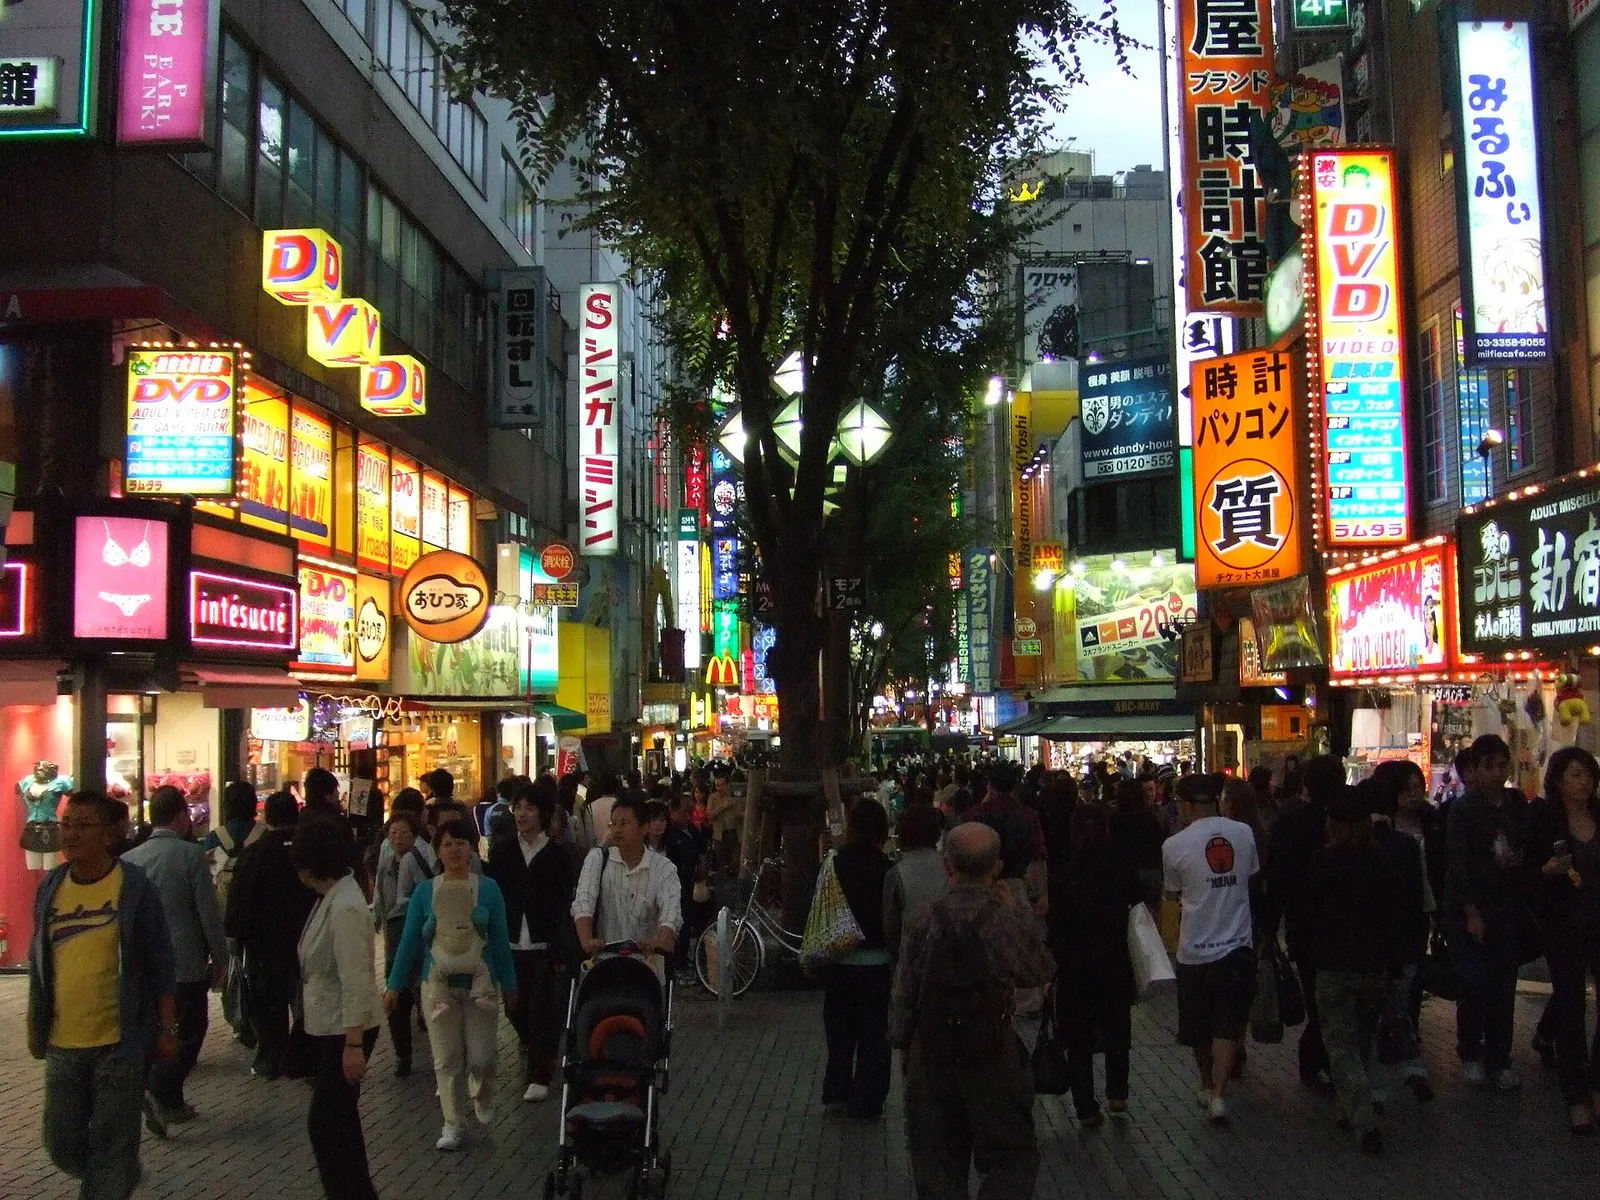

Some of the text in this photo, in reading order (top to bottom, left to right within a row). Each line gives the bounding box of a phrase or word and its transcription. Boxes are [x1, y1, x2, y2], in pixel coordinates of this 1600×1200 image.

[1190, 71, 1268, 94] ブランド
[1317, 159, 1336, 188] 激安
[1196, 100, 1268, 304] 時計館
[1327, 203, 1389, 323] DVD
[1326, 340, 1397, 355] VIDEO
[1204, 352, 1287, 400] 時計
[132, 378, 231, 403] DVD
[1197, 400, 1290, 448] パソコン
[584, 337, 614, 546] シンガーミシン
[1211, 474, 1281, 553] 質
[1530, 503, 1558, 521] ADULT
[1335, 523, 1403, 538] ラムタラ
[543, 555, 570, 569] 消火栓
[1033, 544, 1062, 561] ABC
[307, 571, 346, 603] DVD
[835, 578, 861, 592] モア
[1216, 567, 1281, 584] チケット大黒屋
[200, 592, 286, 634] intésucré
[414, 592, 470, 610] おひつ家
[1475, 605, 1523, 641] 大人の市場
[1531, 618, 1576, 638] SHINJYUKU
